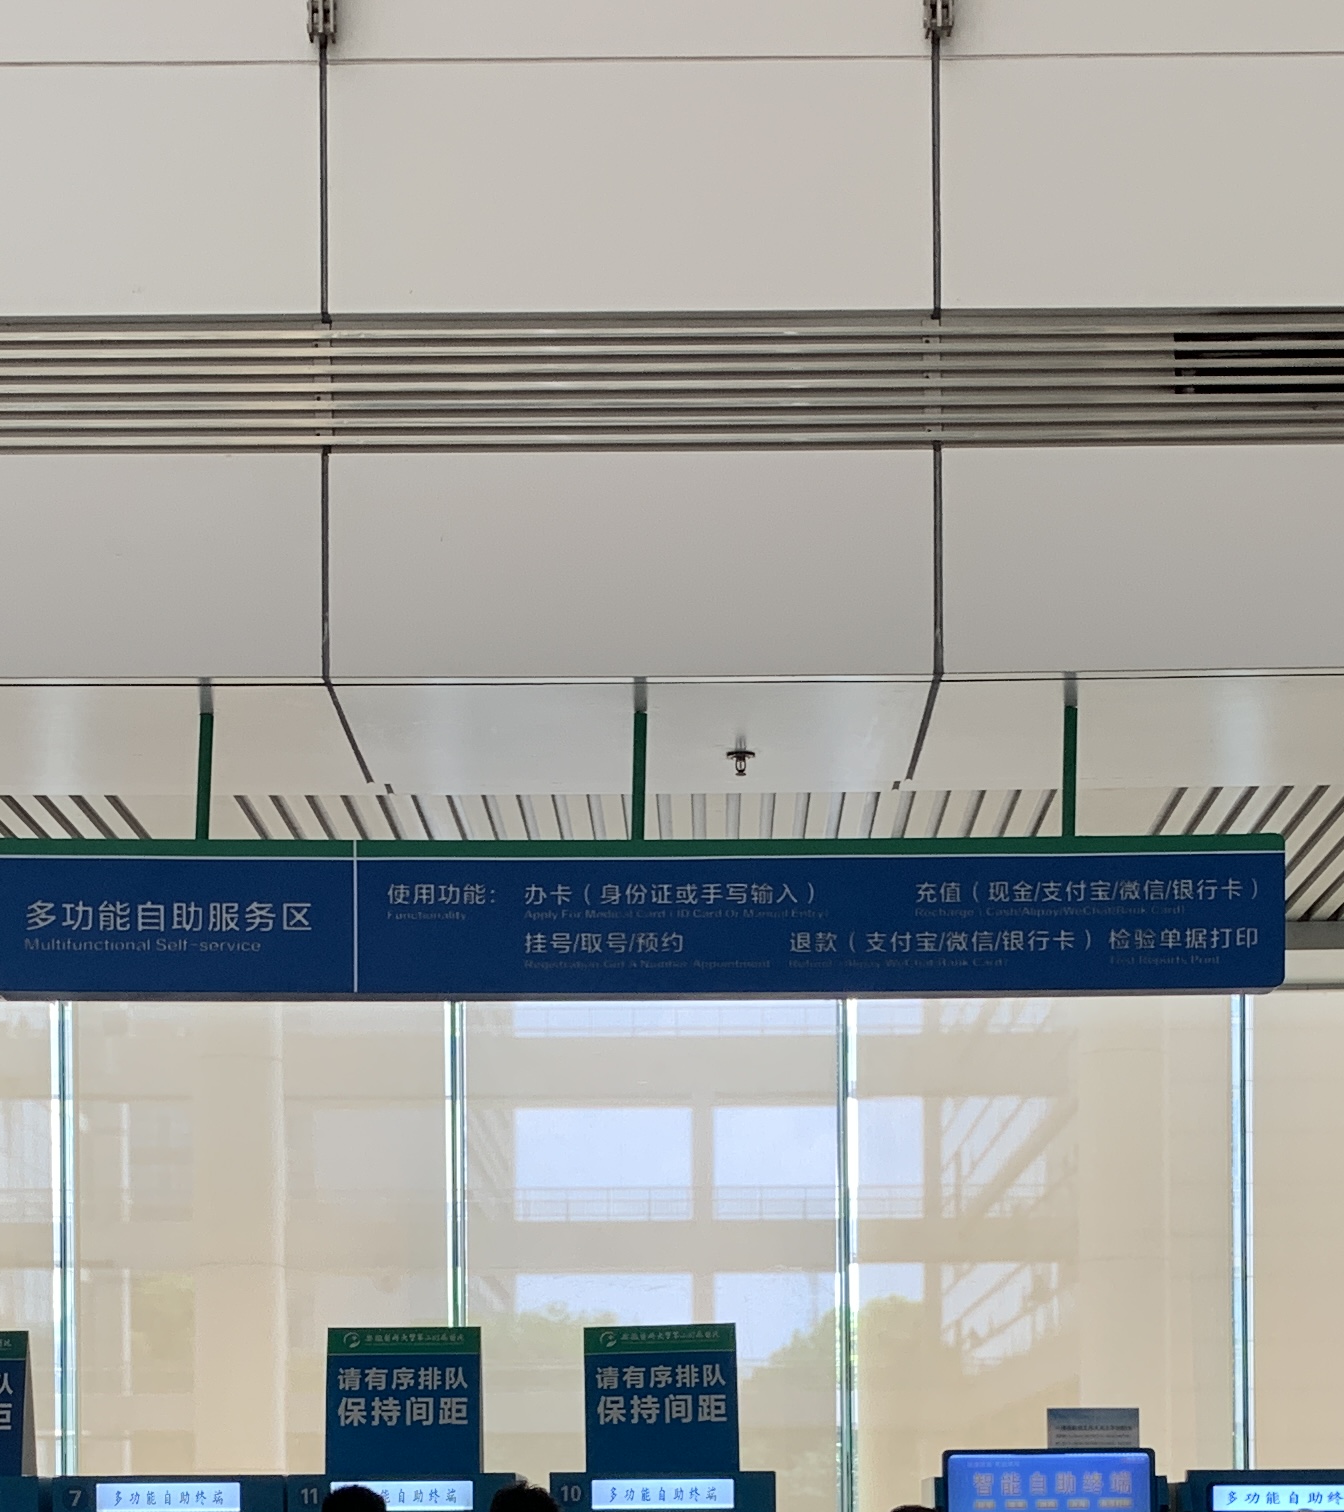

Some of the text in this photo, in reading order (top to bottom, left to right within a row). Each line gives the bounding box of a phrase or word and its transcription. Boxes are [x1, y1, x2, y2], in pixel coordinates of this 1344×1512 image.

[25, 900, 313, 932] 多功能自助服务区
[24, 938, 262, 952] Multifunctional Self-service
[524, 932, 684, 953] 挂号/取号/预约
[1109, 927, 1258, 950] 检验单据打印
[337, 1367, 468, 1391] 请有序排队
[596, 1364, 726, 1389] 请有序排队
[337, 1397, 469, 1427] 保持间距
[597, 1394, 728, 1425] 保持间距
[560, 1485, 581, 1502] 10
[609, 1486, 718, 1502] 多功能自助终端
[973, 1471, 1133, 1496] 智能自助终端
[68, 1489, 82, 1507] 7
[114, 1490, 224, 1506] 多功能自助终端
[300, 1488, 318, 1504] 11
